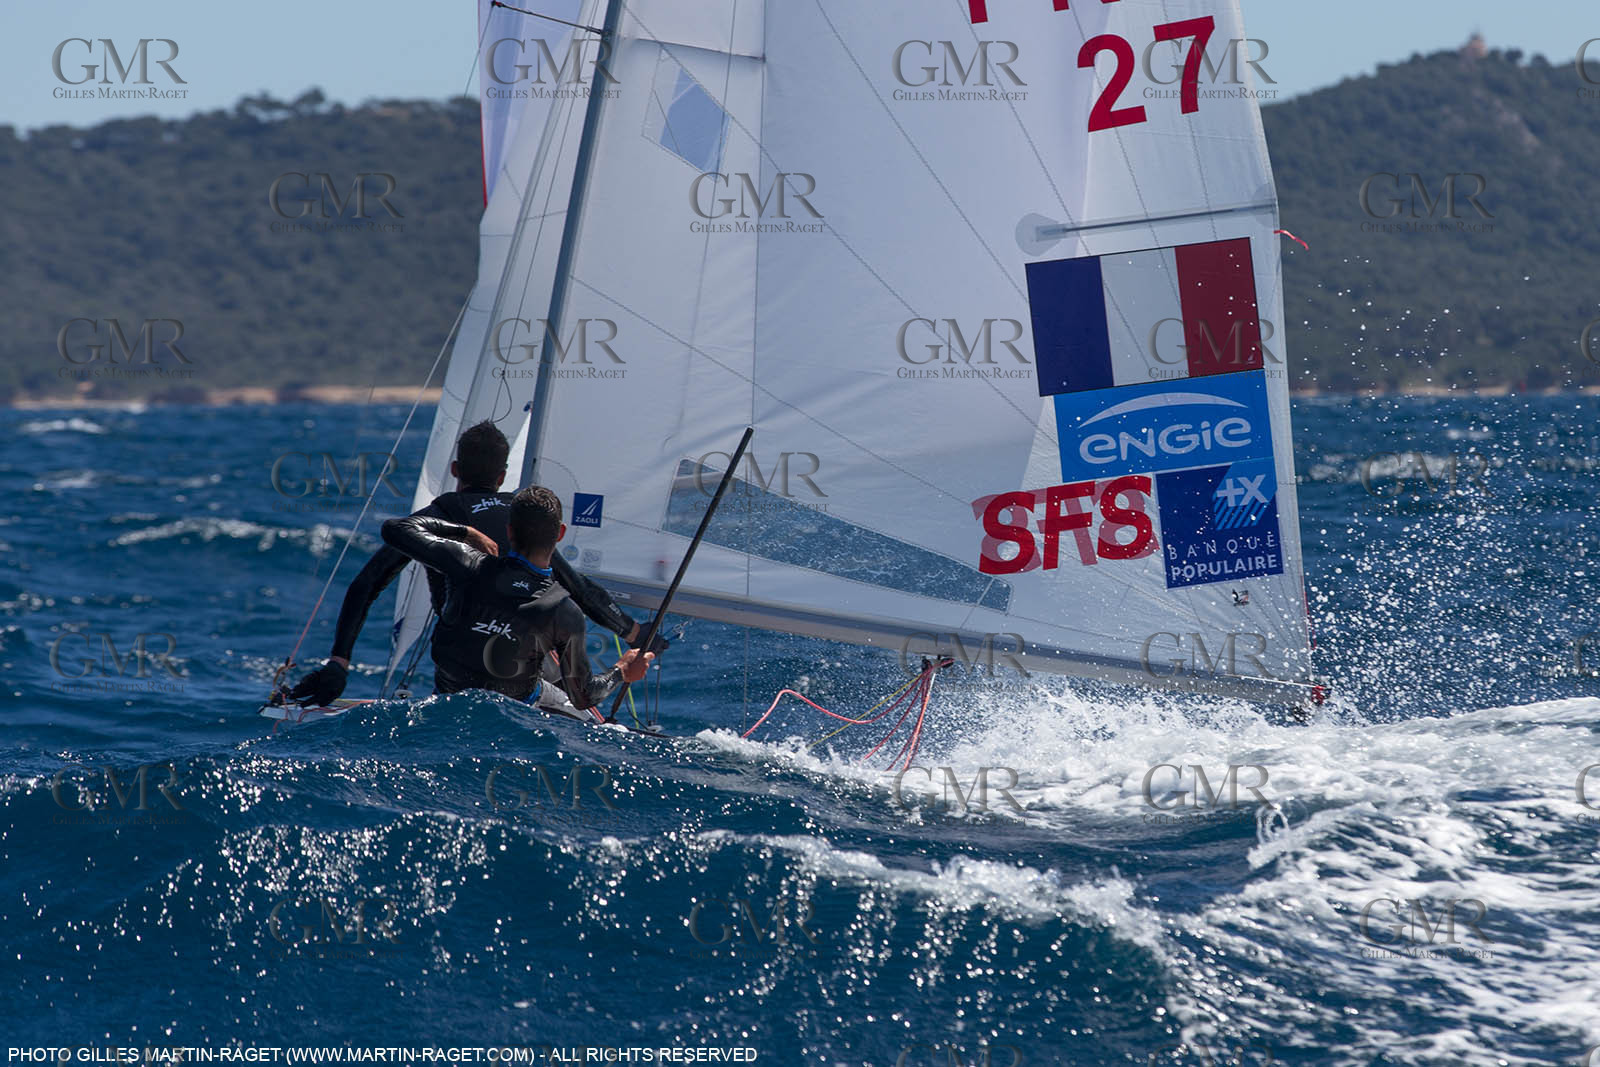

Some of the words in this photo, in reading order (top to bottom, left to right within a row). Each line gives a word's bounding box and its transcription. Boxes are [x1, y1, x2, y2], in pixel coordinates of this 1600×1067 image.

[1077, 15, 1215, 133] 27
[575, 516, 599, 524] ZAOLI
[978, 475, 1152, 575] SFS
[1169, 534, 1276, 560] BANQUE
[1171, 555, 1277, 580] POPULAIRE
